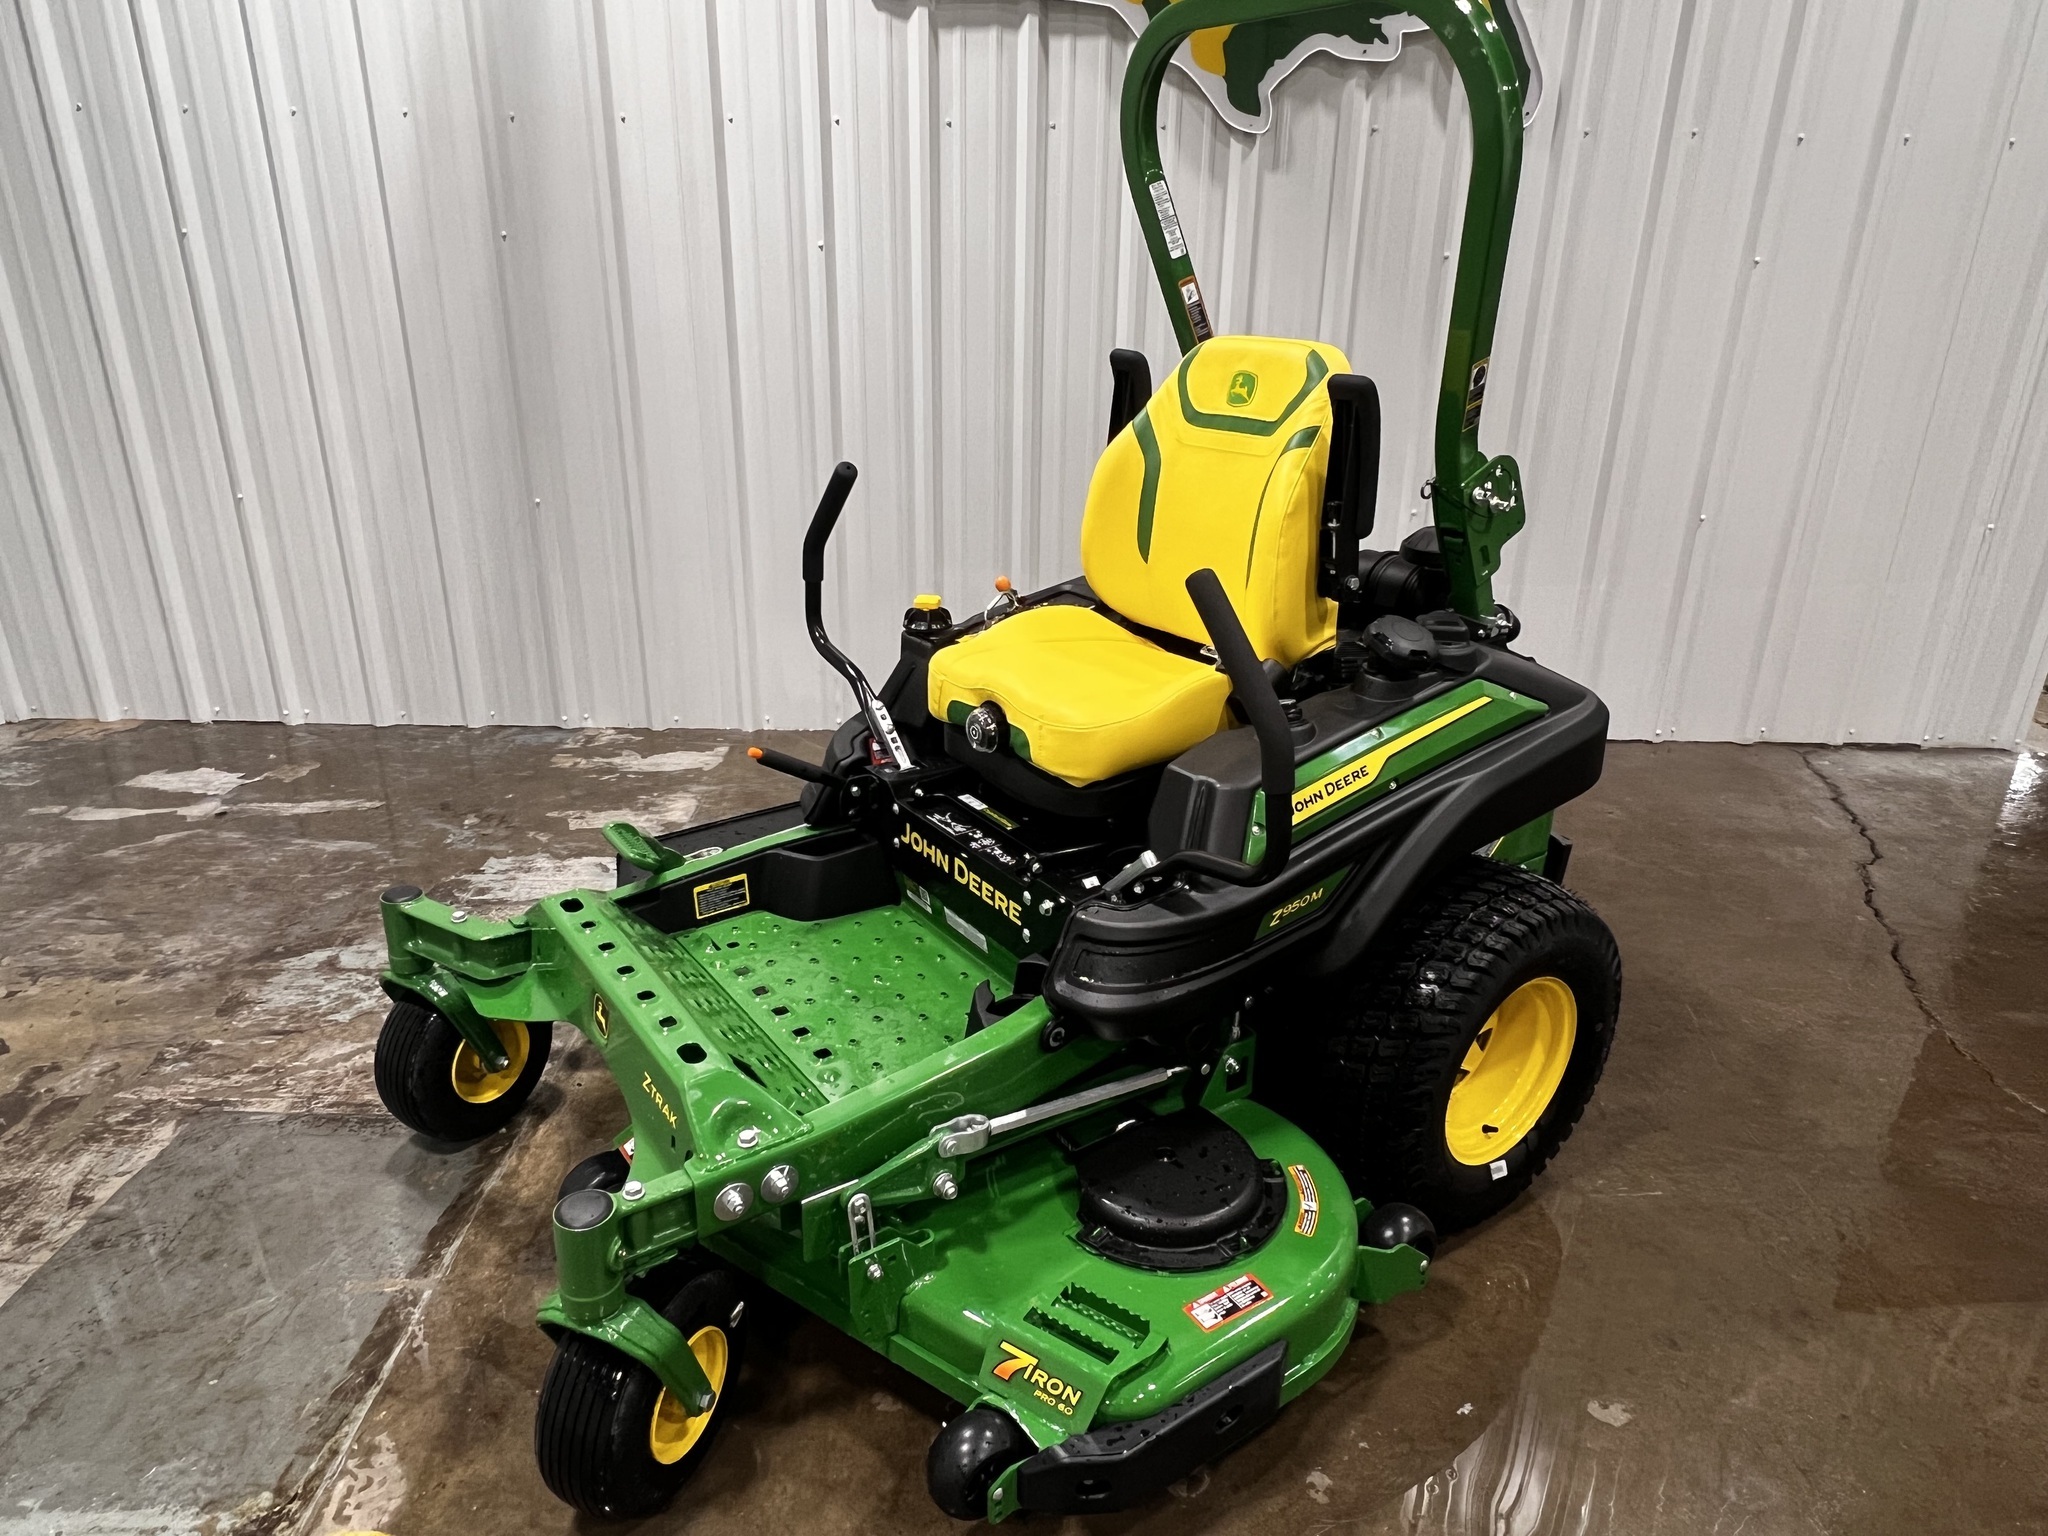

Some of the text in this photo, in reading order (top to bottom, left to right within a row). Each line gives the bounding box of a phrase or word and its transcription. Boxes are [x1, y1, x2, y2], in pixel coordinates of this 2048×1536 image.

[1292, 765, 1369, 816] OHN DEERE
[901, 823, 949, 873] JOHN
[954, 857, 1022, 926] DEERE
[1270, 888, 1323, 926] Z950M
[642, 1071, 678, 1129] ZTRAK
[1033, 1389, 1056, 1406] PRO
